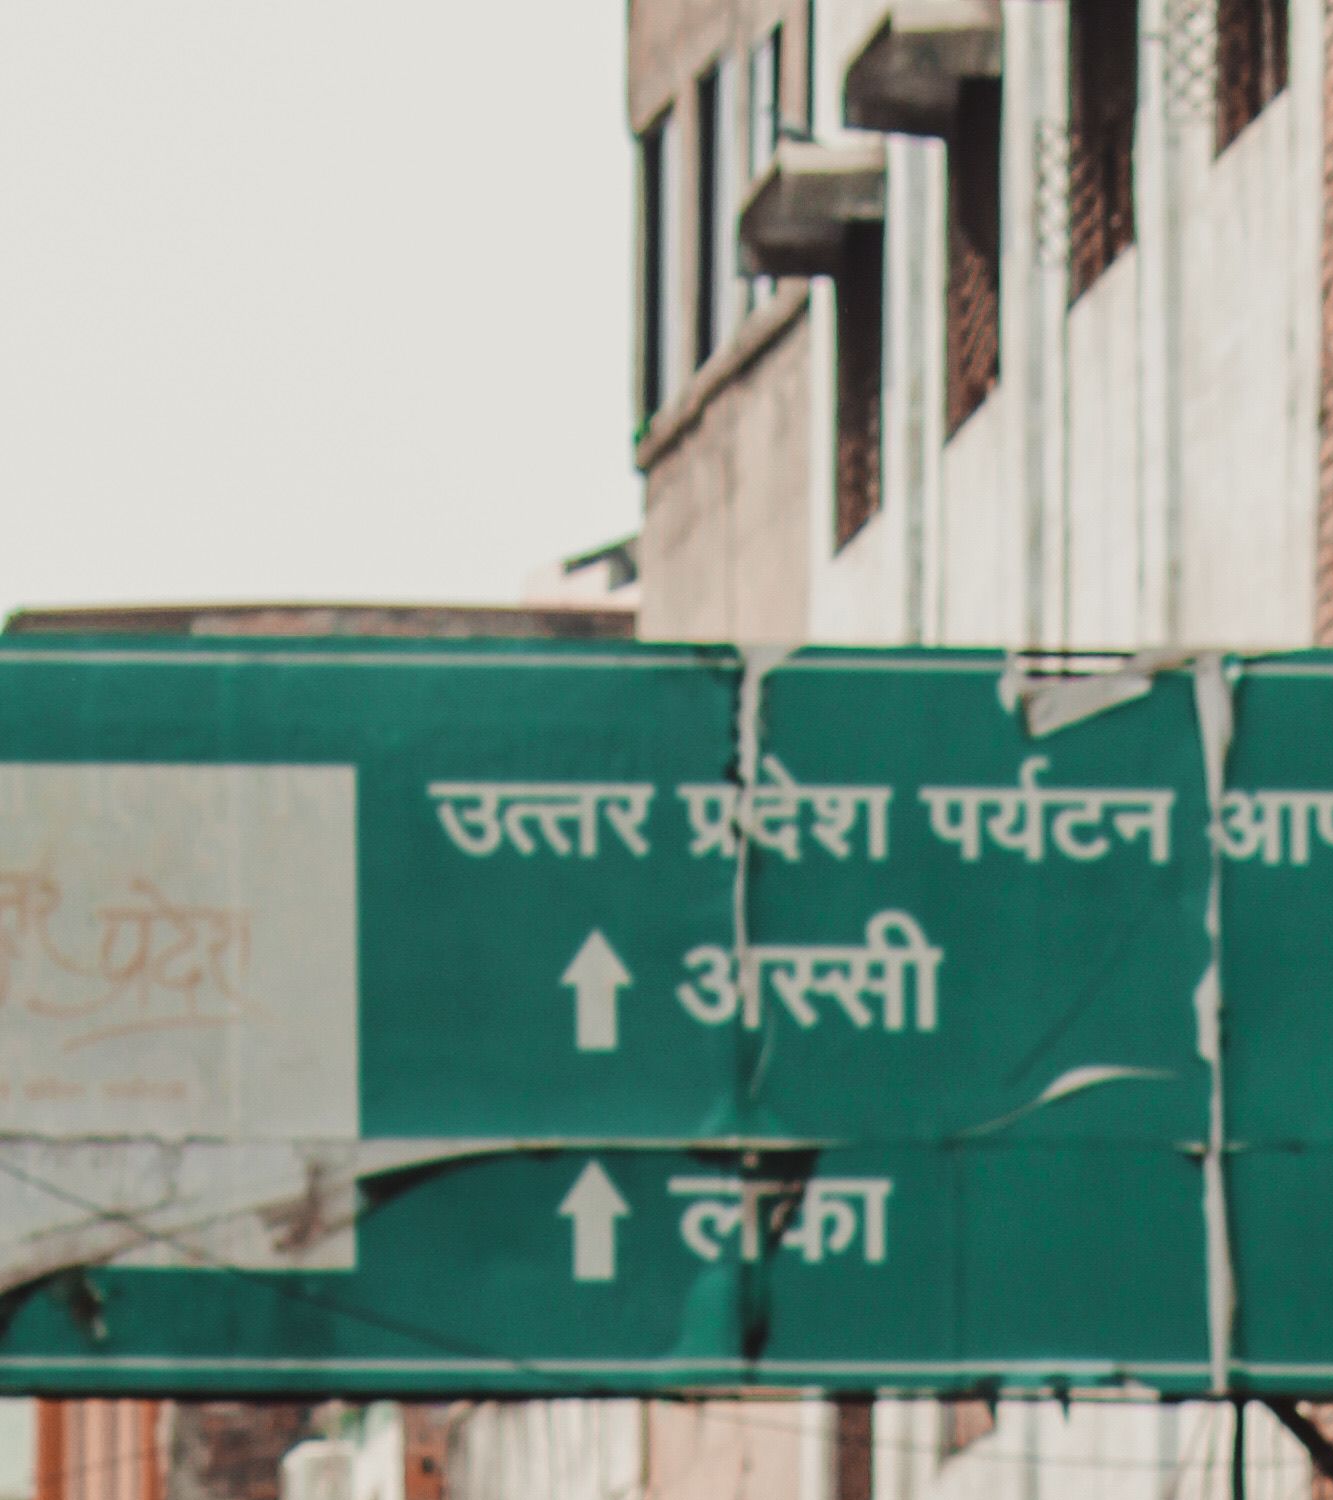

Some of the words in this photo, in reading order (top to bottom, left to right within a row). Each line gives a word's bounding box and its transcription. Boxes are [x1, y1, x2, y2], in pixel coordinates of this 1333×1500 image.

[428, 780, 653, 858] उत्तर
[677, 758, 891, 862] प्रदेश
[918, 757, 1175, 864] पर्यटन
[677, 911, 943, 1034] अस्सी
